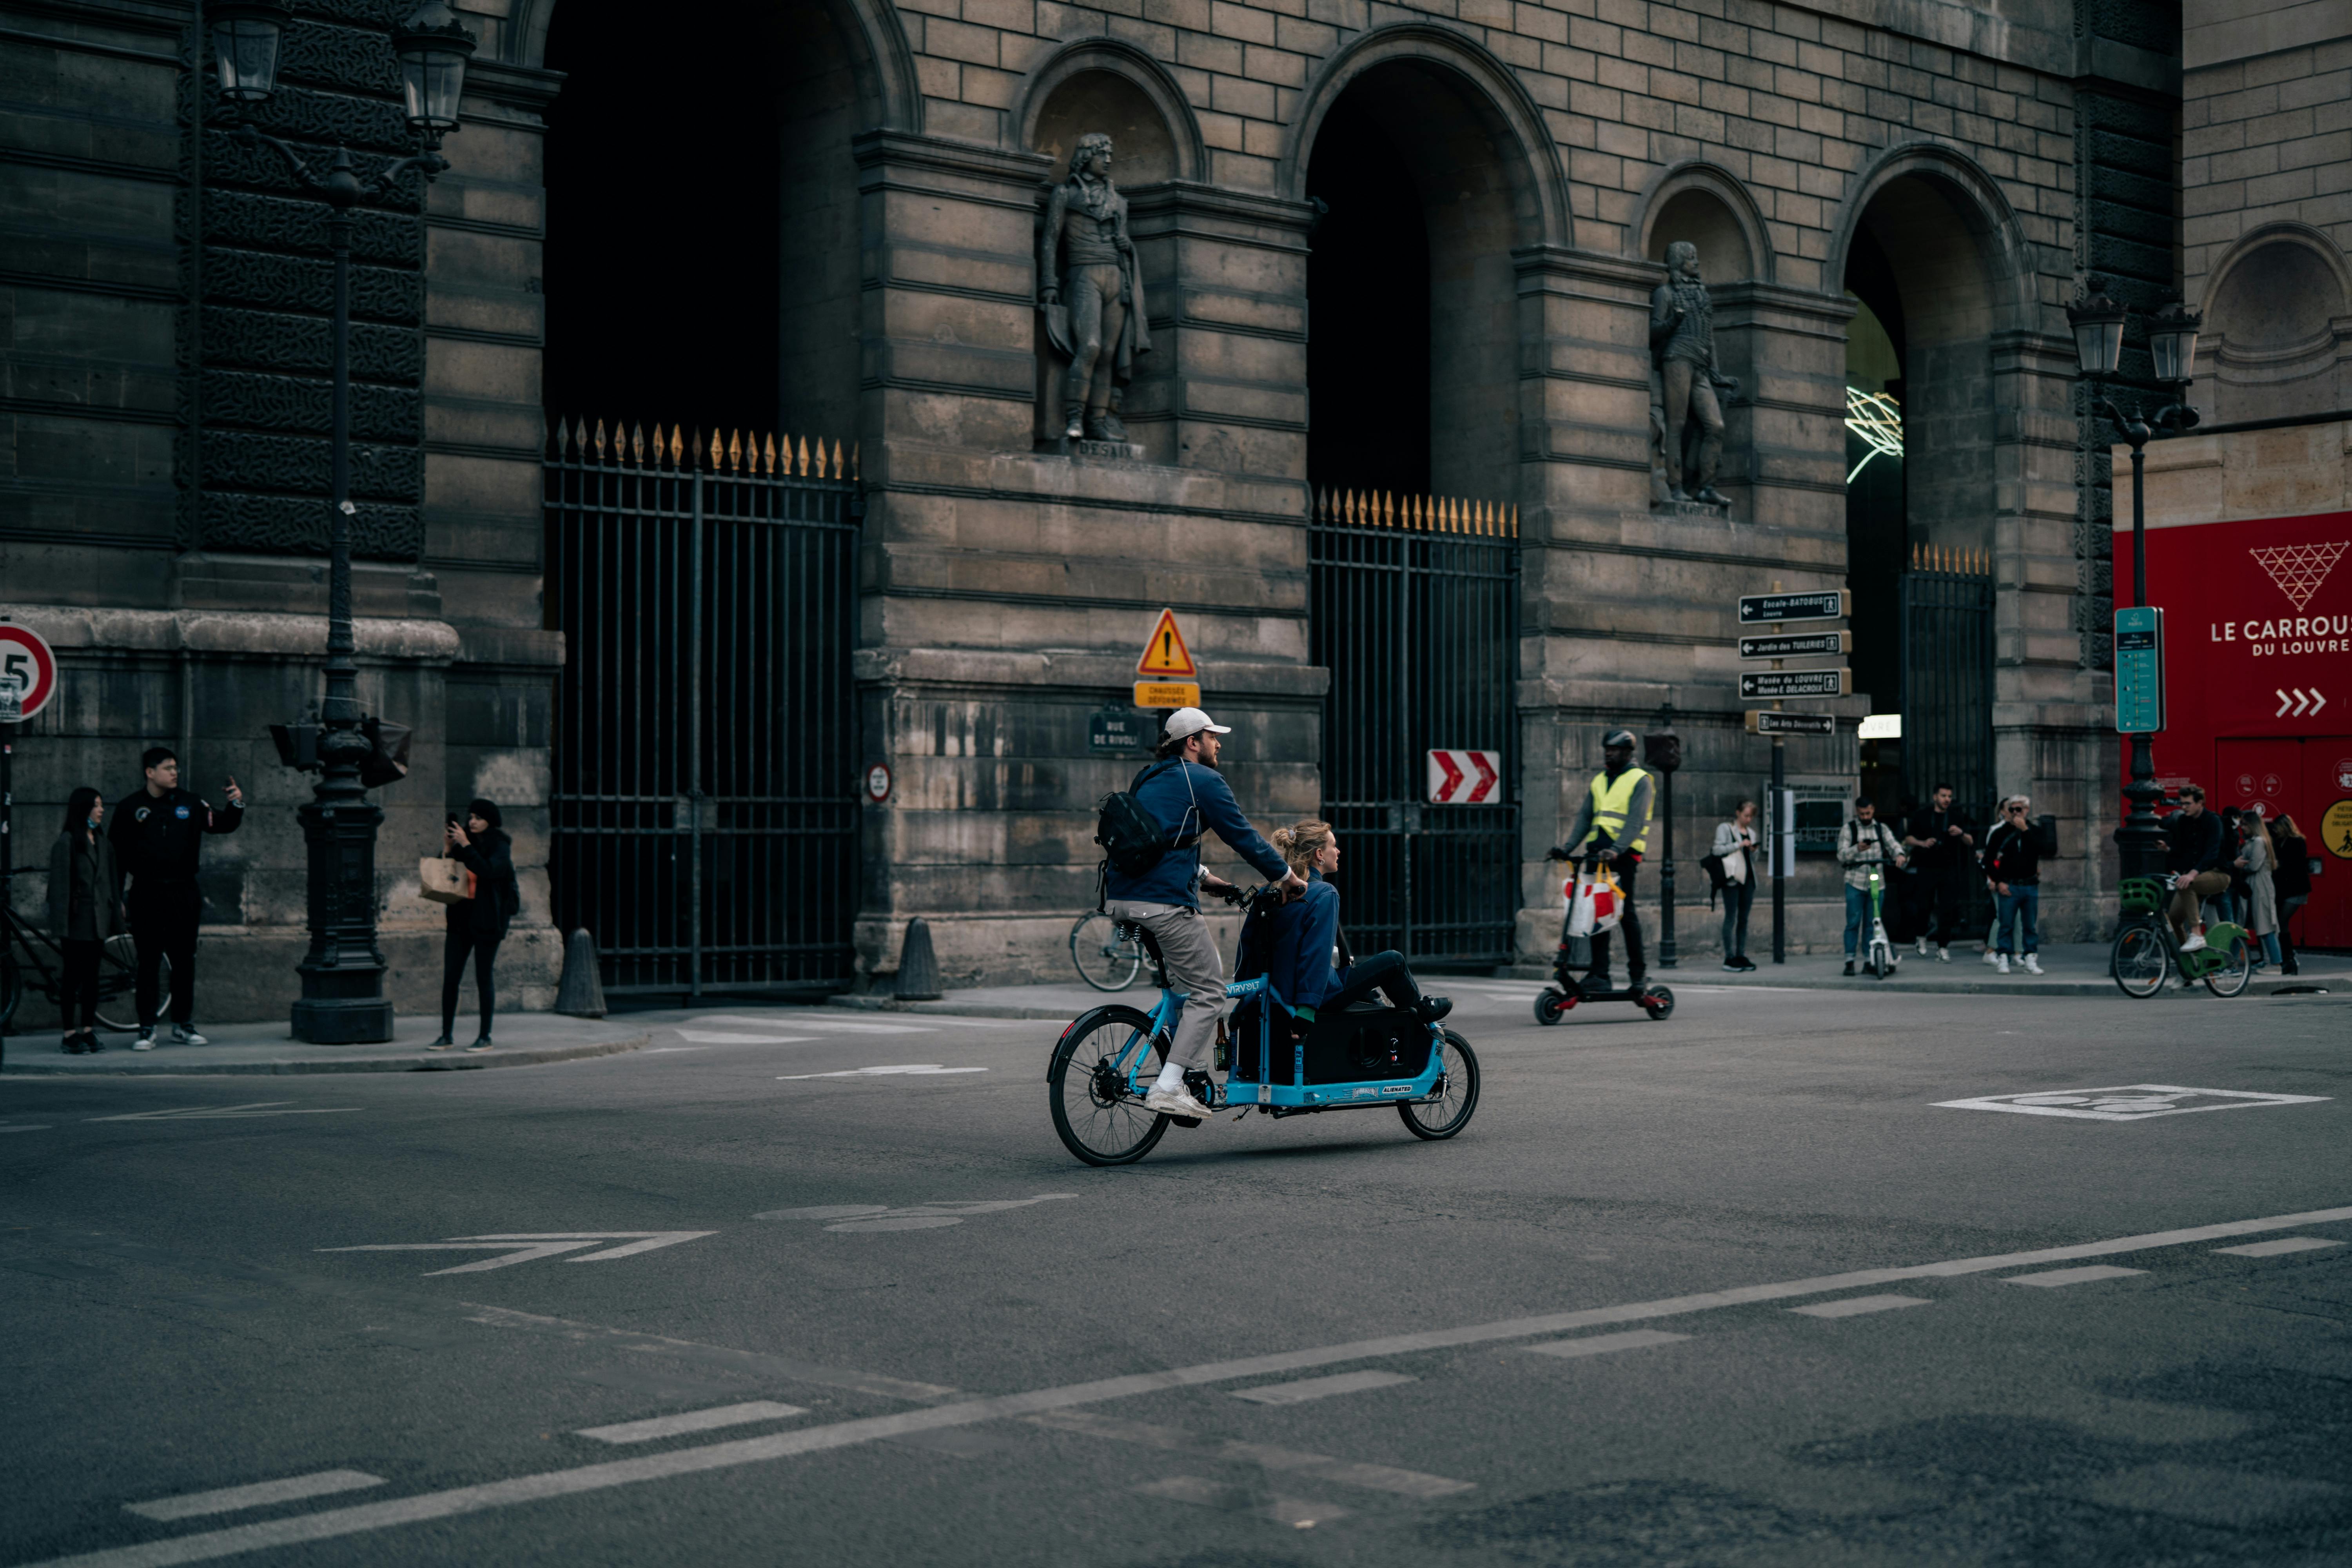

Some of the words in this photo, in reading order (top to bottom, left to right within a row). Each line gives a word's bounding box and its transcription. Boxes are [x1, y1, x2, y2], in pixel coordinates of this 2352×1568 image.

[1080, 443, 1132, 459] DESAIX
[2211, 622, 2236, 642] LE
[1757, 642, 1778, 652] Jardin
[1779, 641, 1791, 651] des
[2252, 643, 2274, 656] DU
[2282, 639, 2350, 655] LOUVRE
[1783, 675, 1793, 684] du
[1794, 674, 1823, 683] LOUVRE
[1786, 684, 1823, 693] DELACROIX
[1106, 721, 1125, 732] RUE
[1094, 734, 1106, 745] DE
[1226, 981, 1259, 995] VIRVOLT
